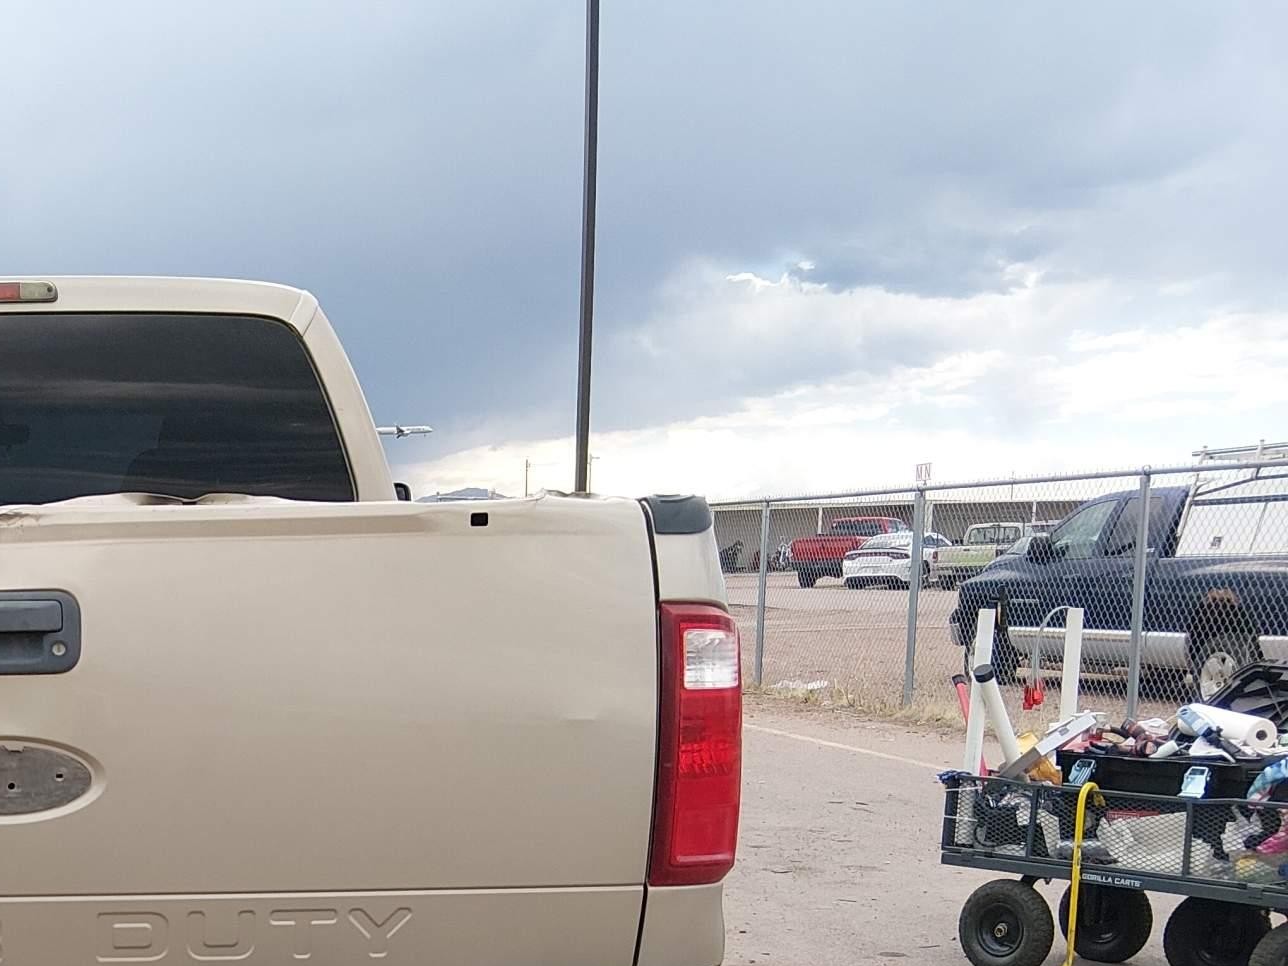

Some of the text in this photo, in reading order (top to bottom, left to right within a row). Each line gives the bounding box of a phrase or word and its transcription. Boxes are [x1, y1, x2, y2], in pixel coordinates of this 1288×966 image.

[1082, 873, 1142, 888] GORILLA CARTS
[96, 907, 413, 963] DUTY
